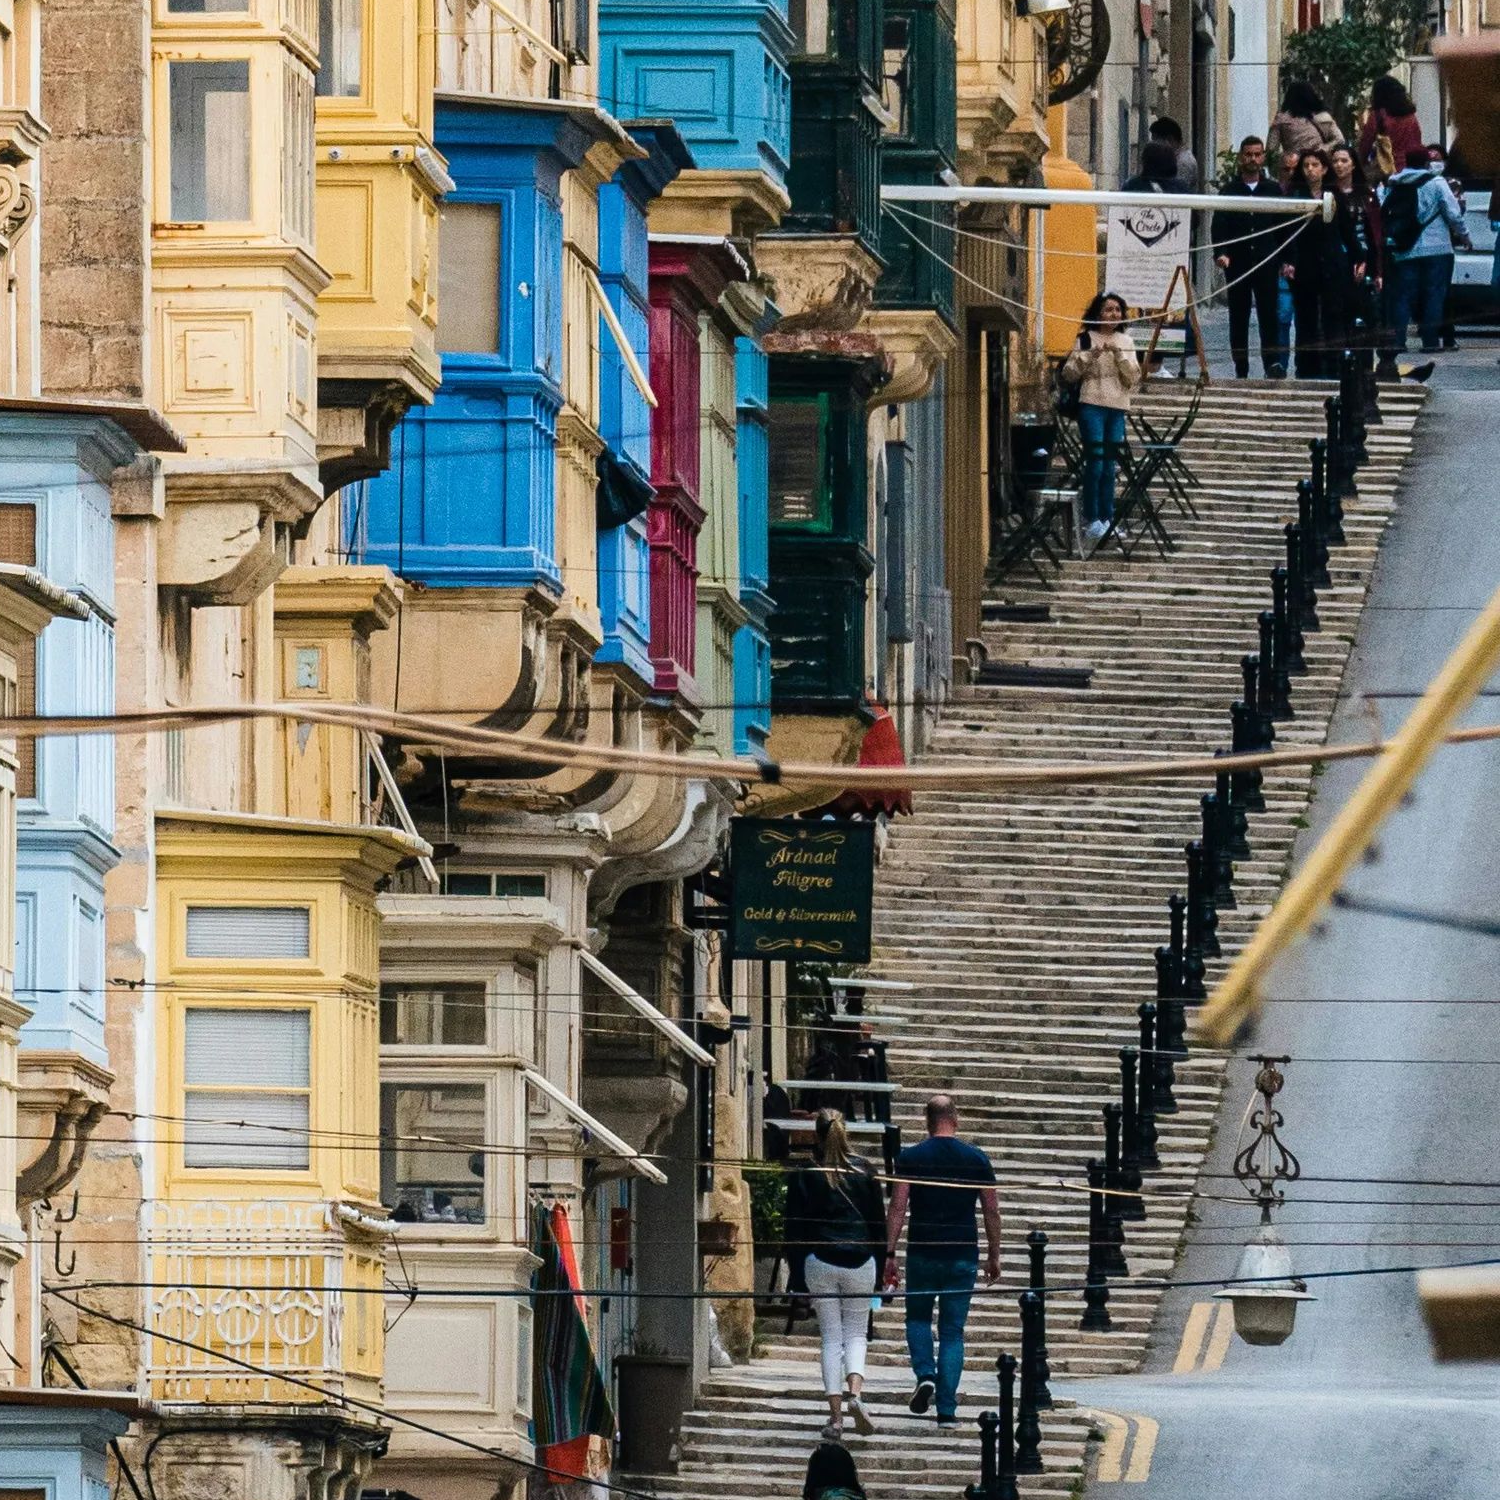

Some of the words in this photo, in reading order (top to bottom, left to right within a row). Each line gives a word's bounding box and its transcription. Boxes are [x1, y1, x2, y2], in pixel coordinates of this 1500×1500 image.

[773, 869, 833, 892] Filigree
[744, 907, 772, 920] Gold
[789, 907, 857, 922] Silversmith
